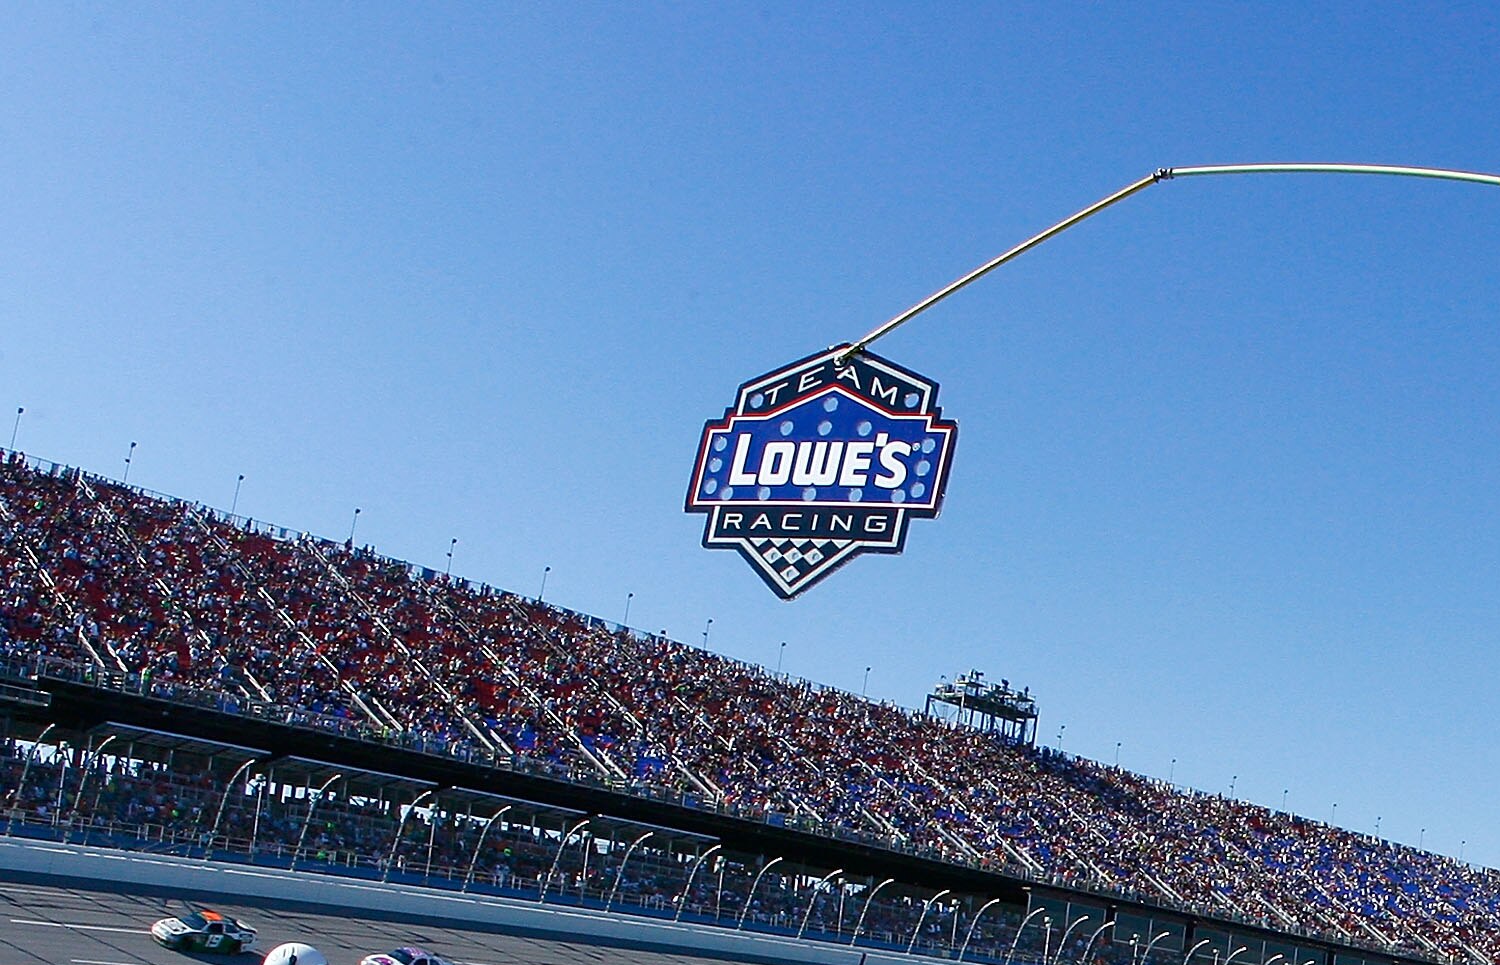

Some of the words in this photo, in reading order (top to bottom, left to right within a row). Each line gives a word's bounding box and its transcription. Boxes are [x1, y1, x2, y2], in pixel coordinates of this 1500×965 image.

[764, 365, 898, 406] TEAM
[728, 432, 911, 488] LOWE'S
[723, 513, 888, 532] RACING
